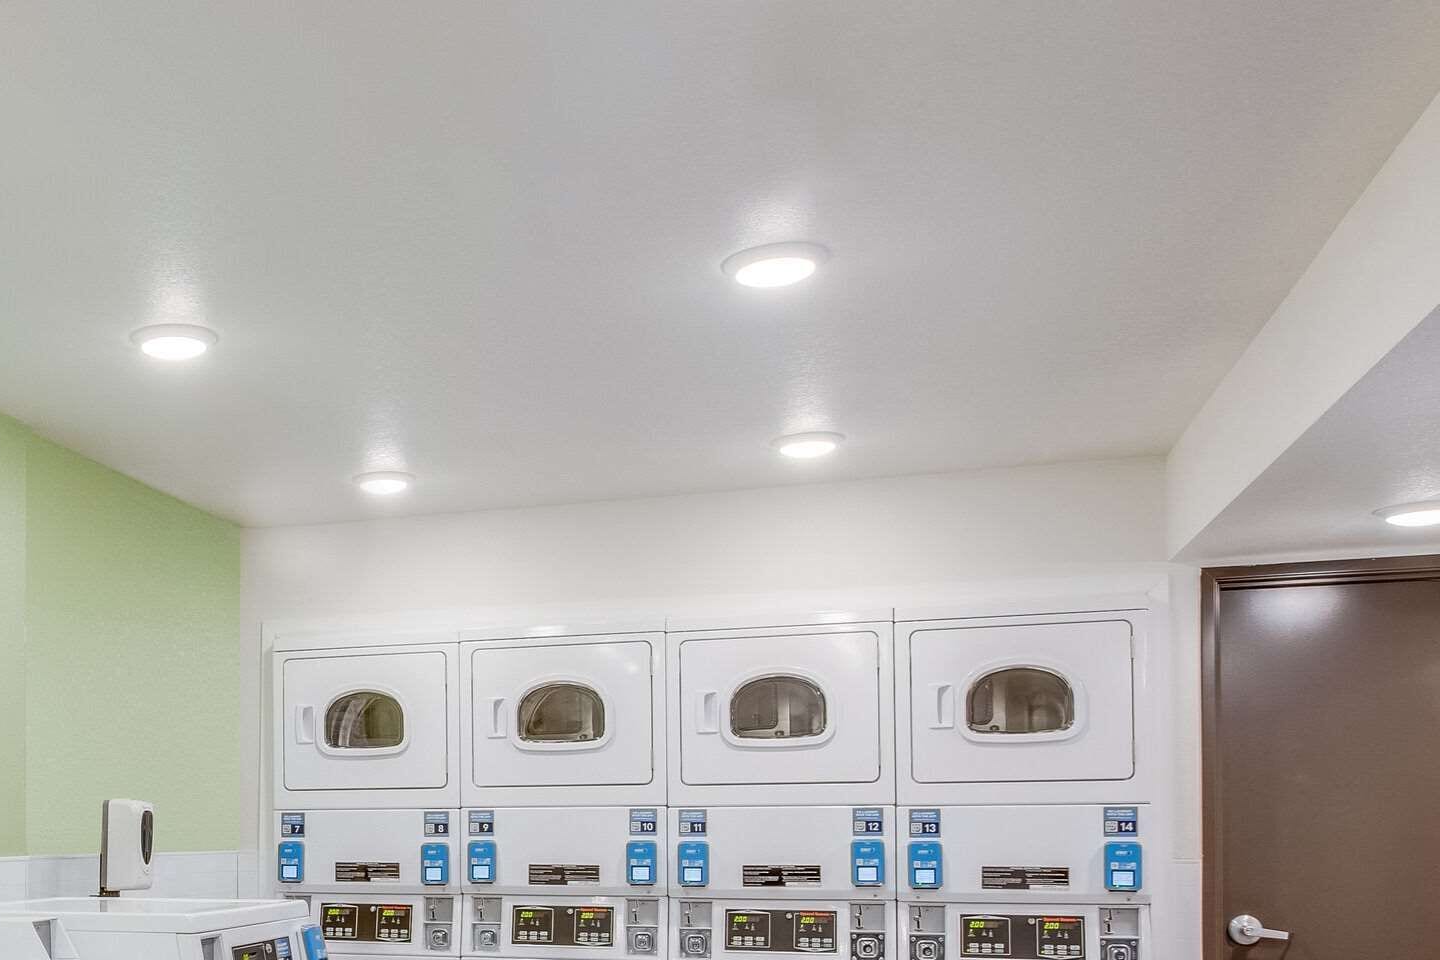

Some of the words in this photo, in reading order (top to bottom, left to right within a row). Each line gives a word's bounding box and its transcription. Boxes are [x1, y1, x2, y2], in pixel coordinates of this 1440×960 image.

[868, 823, 879, 831] 12
[924, 824, 936, 832] 13
[1120, 822, 1133, 831] 14
